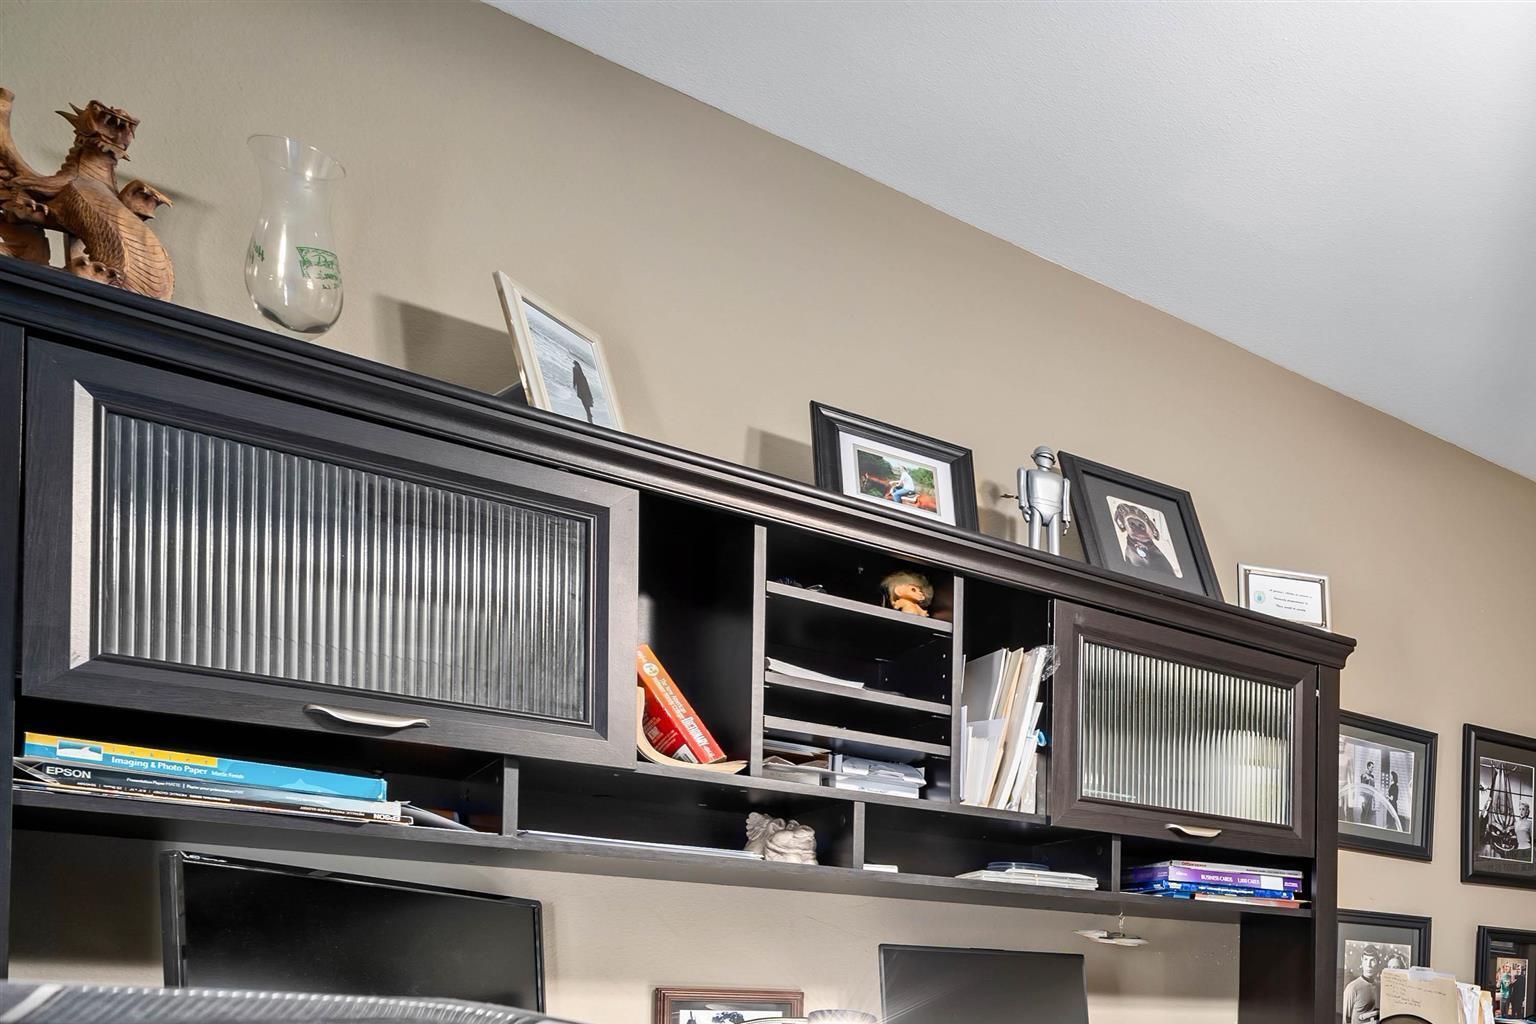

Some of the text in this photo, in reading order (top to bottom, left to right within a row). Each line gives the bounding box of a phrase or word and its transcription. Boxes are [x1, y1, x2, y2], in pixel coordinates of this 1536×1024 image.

[112, 756, 148, 769] Imaging
[150, 760, 157, 768] &
[158, 762, 182, 772] Photo
[184, 765, 207, 775] Paper
[46, 766, 91, 779] EPSON
[373, 813, 400, 822] EPSON
